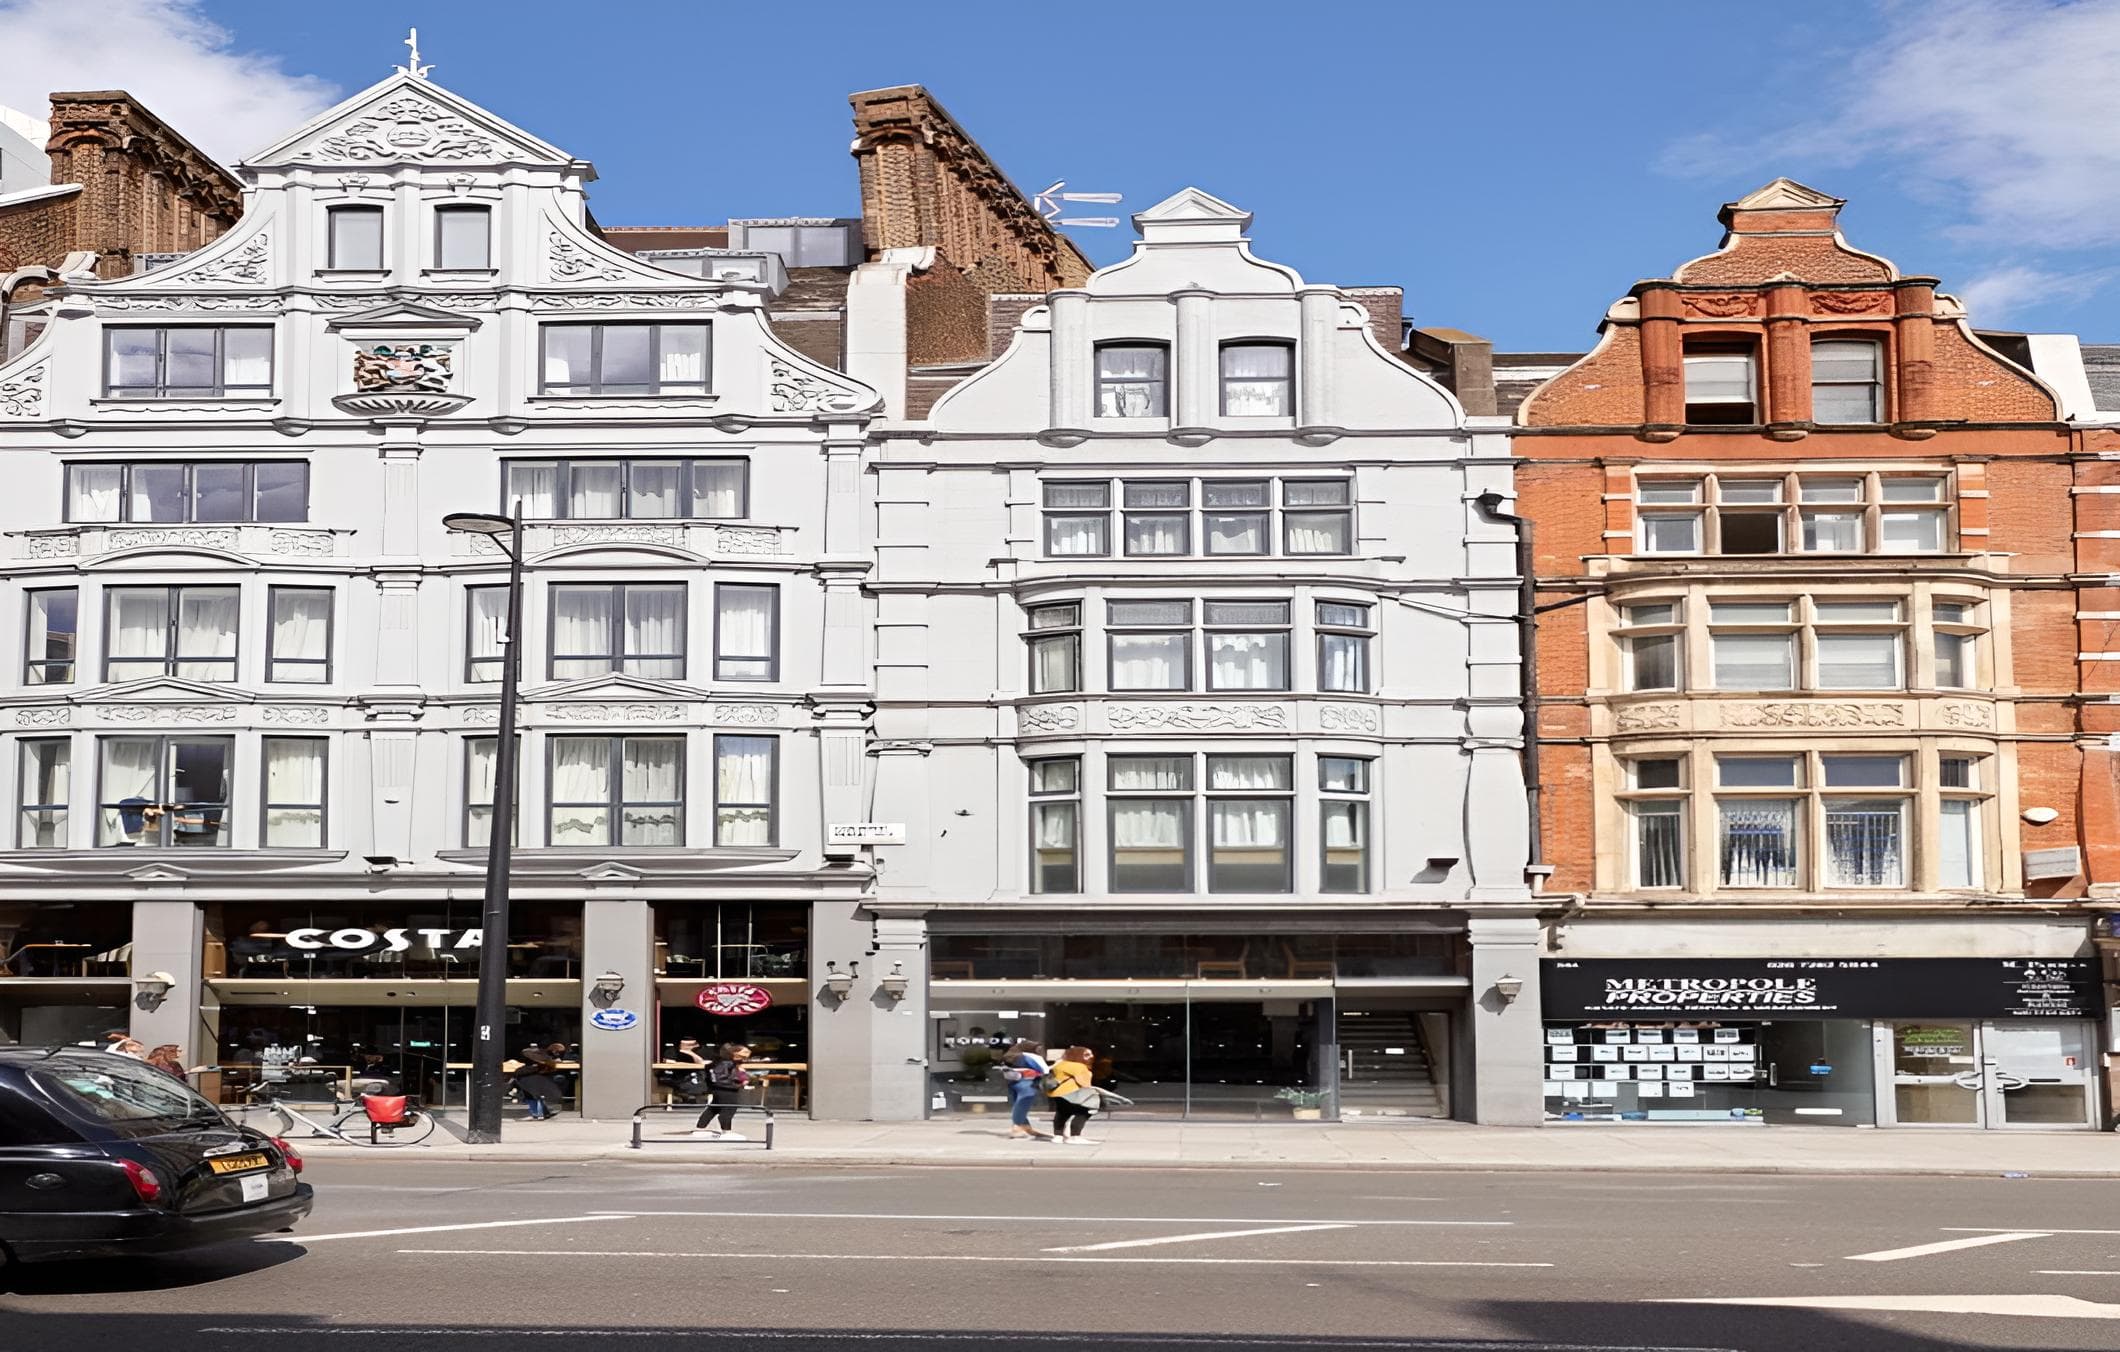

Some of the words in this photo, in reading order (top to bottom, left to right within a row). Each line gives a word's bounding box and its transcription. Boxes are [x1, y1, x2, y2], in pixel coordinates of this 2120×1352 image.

[285, 928, 483, 951] COSTA
[1606, 978, 1816, 990] METROPOLE
[1605, 989, 1816, 1004] PROPERTIES
